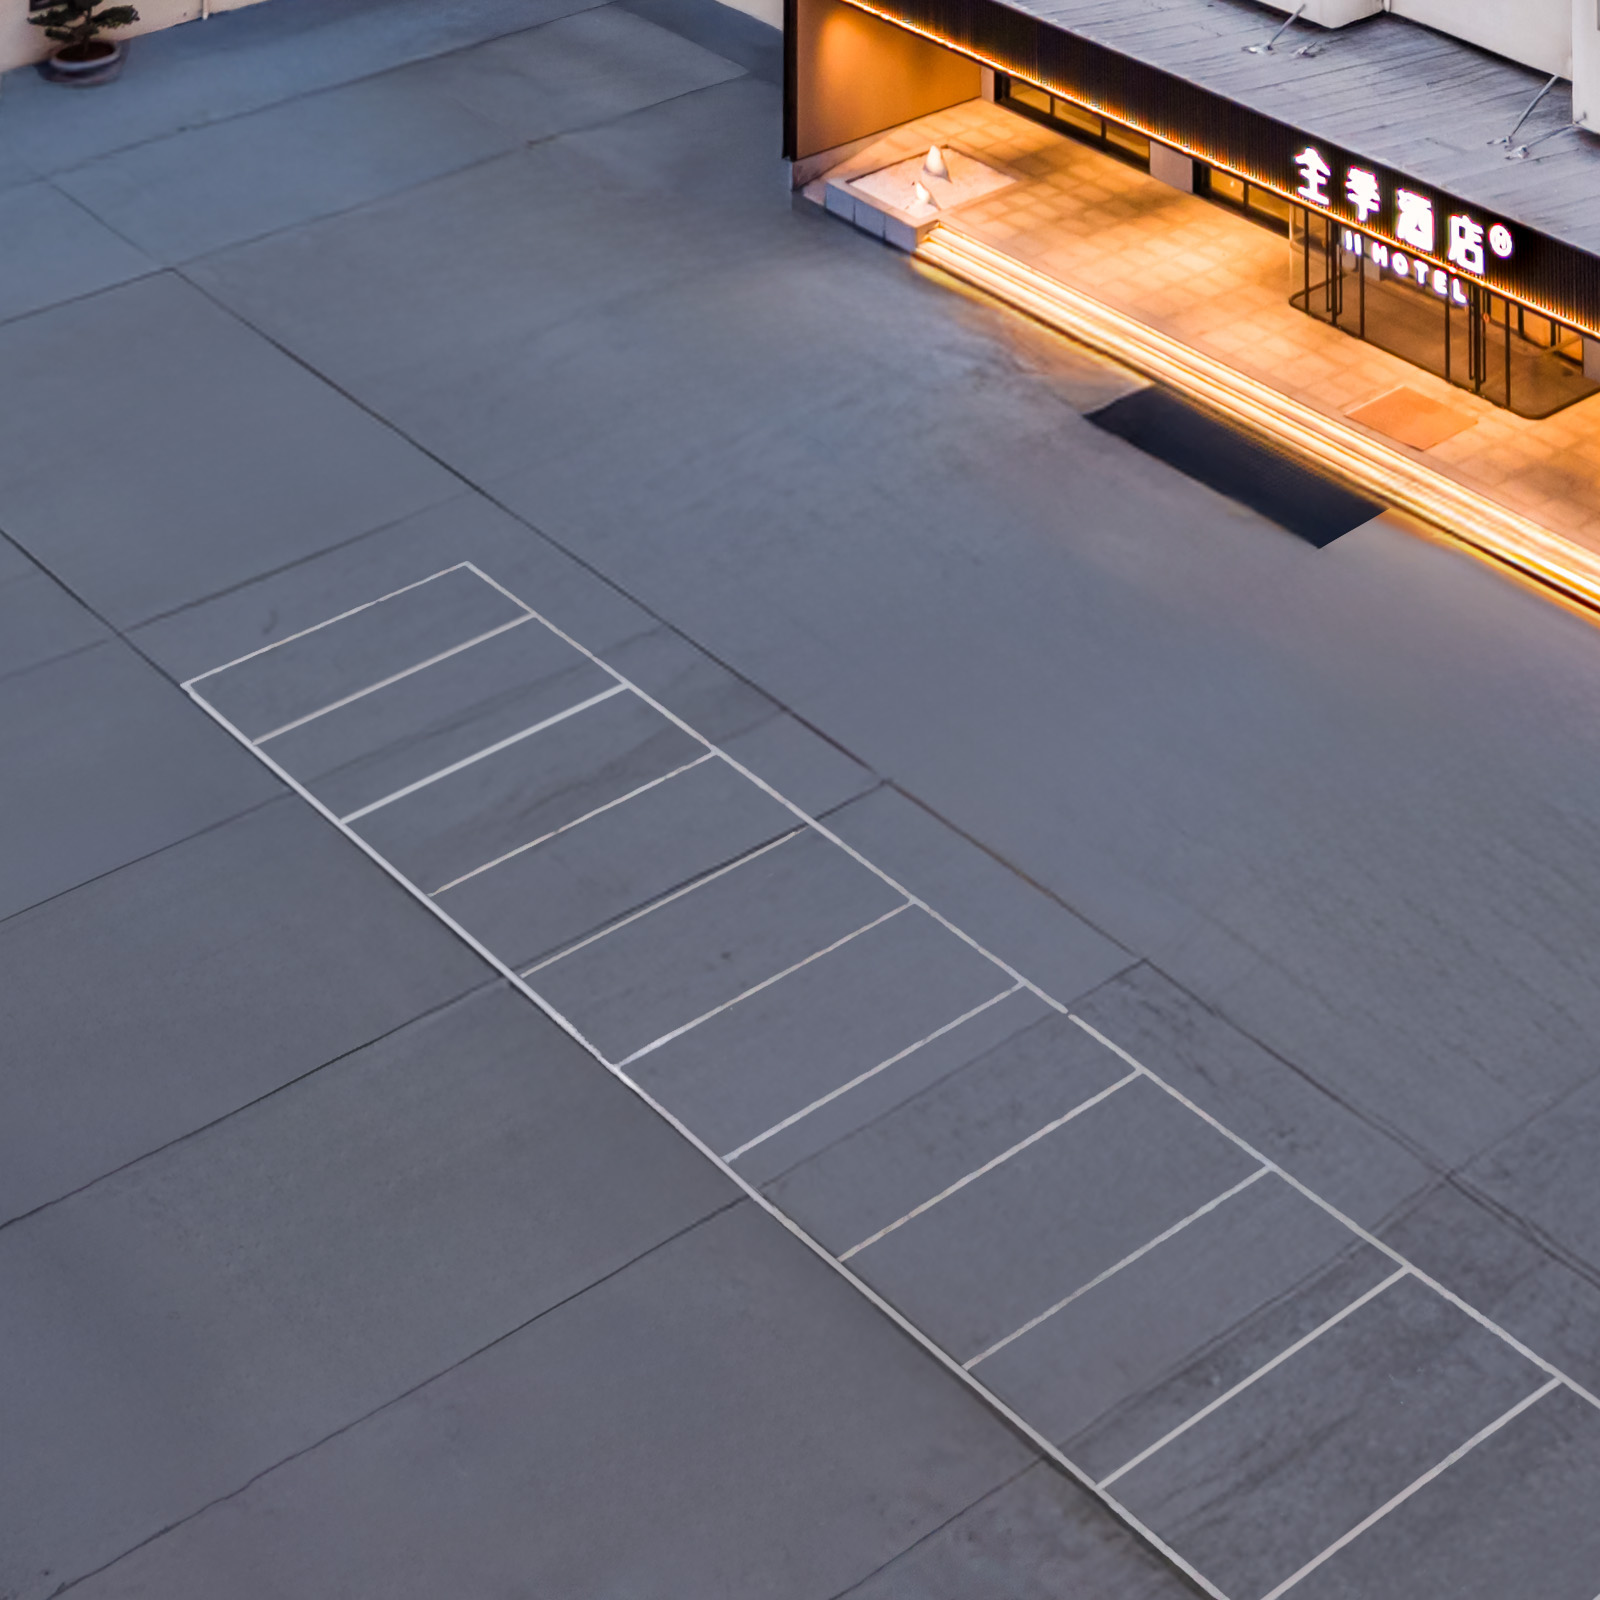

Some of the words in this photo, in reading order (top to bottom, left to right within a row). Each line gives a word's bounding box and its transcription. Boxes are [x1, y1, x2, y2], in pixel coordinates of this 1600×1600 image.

[1294, 147, 1484, 275] 全季酒店
[1371, 241, 1467, 305] HOTEL
